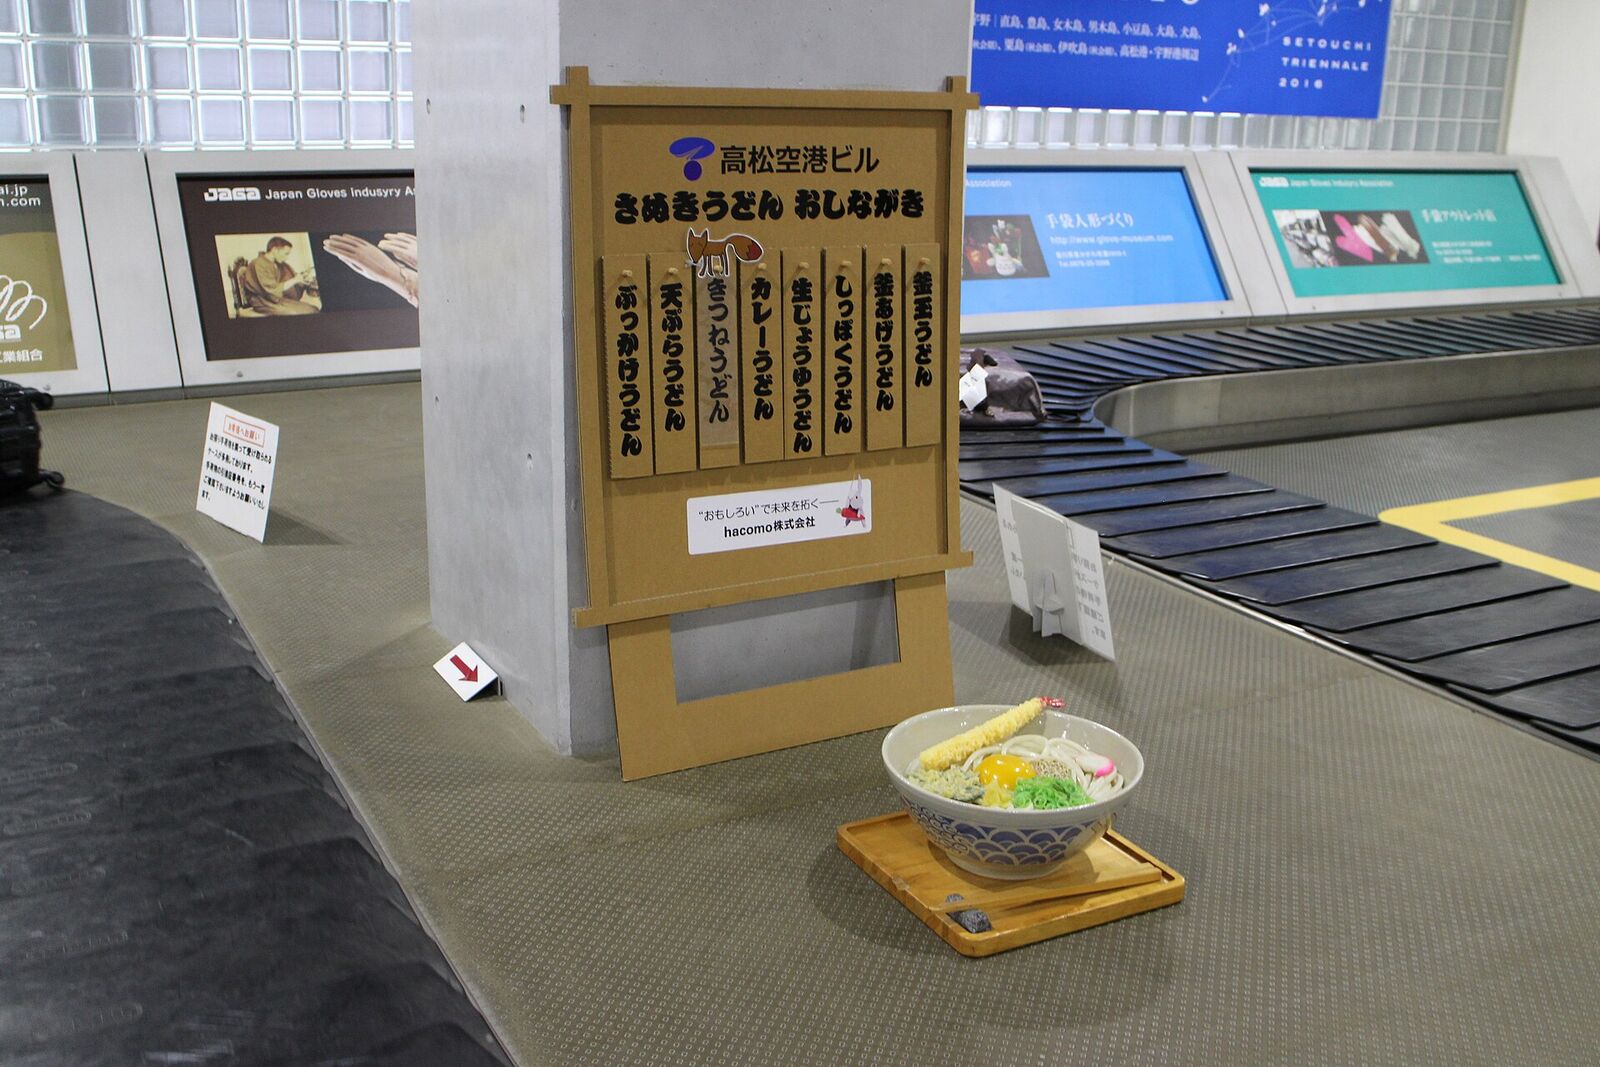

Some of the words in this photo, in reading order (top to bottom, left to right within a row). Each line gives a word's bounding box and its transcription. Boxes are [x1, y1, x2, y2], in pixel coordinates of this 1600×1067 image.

[1282, 36, 1371, 51] SETOUCHI
[1281, 57, 1369, 71] TRIENNALE
[1279, 77, 1323, 89] 2016
[720, 144, 880, 175] 高松空港ビル
[265, 189, 303, 201] Japan
[306, 188, 348, 200] Gloves
[350, 186, 401, 198] Indusyry
[614, 189, 784, 225] さぬきうどん
[795, 188, 924, 220] おしながき
[1046, 211, 1134, 229] 手袋人形づくり
[873, 272, 894, 412] 釜あげうどん
[912, 271, 933, 388] 釜玉うどん
[0, 348, 43, 363] 業組合
[660, 282, 686, 433] 天ぷらうどん
[707, 279, 730, 424] きつねうどん
[751, 276, 774, 421] カレーうどん
[791, 277, 812, 454] 生じょうゆうどん
[833, 274, 853, 434] しっぽくうどん
[615, 284, 642, 457] ぶっかけうどん
[724, 516, 816, 539] hacomo株式会社
